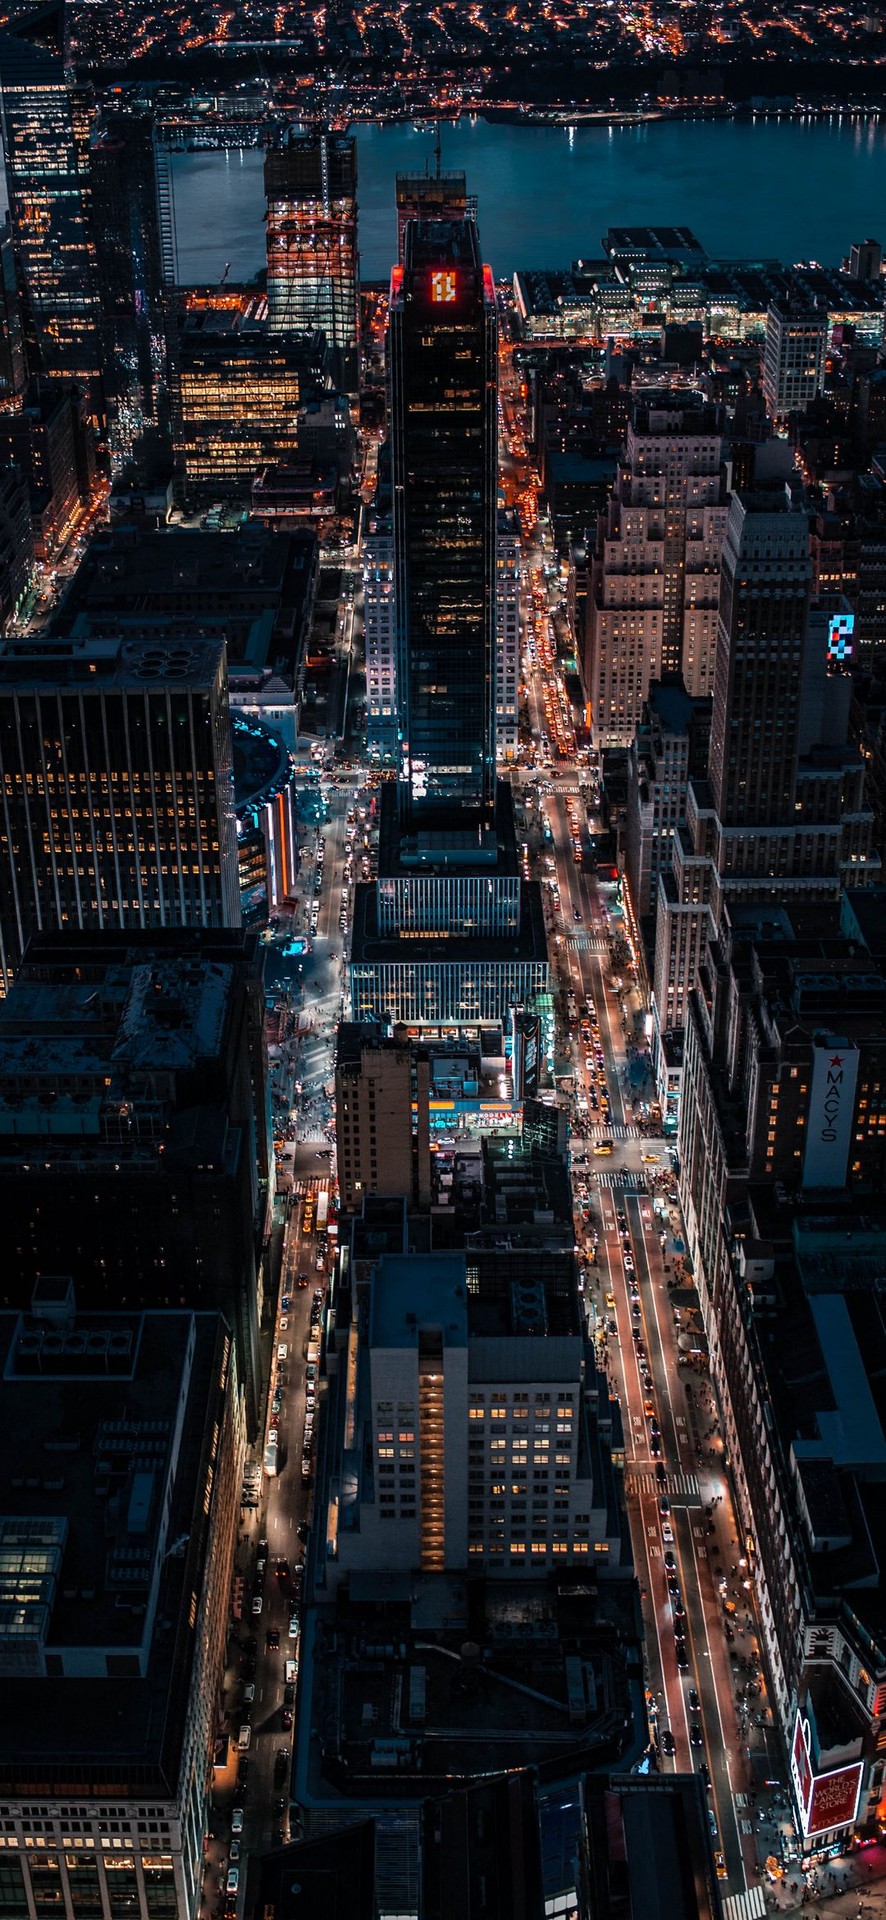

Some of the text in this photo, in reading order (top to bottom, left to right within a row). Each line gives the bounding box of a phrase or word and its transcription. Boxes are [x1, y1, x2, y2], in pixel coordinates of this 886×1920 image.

[821, 1070, 843, 1142] MACYS
[829, 1774, 845, 1786] THE
[814, 1787, 853, 1806] LARGEST
[819, 1798, 847, 1812] STORE
